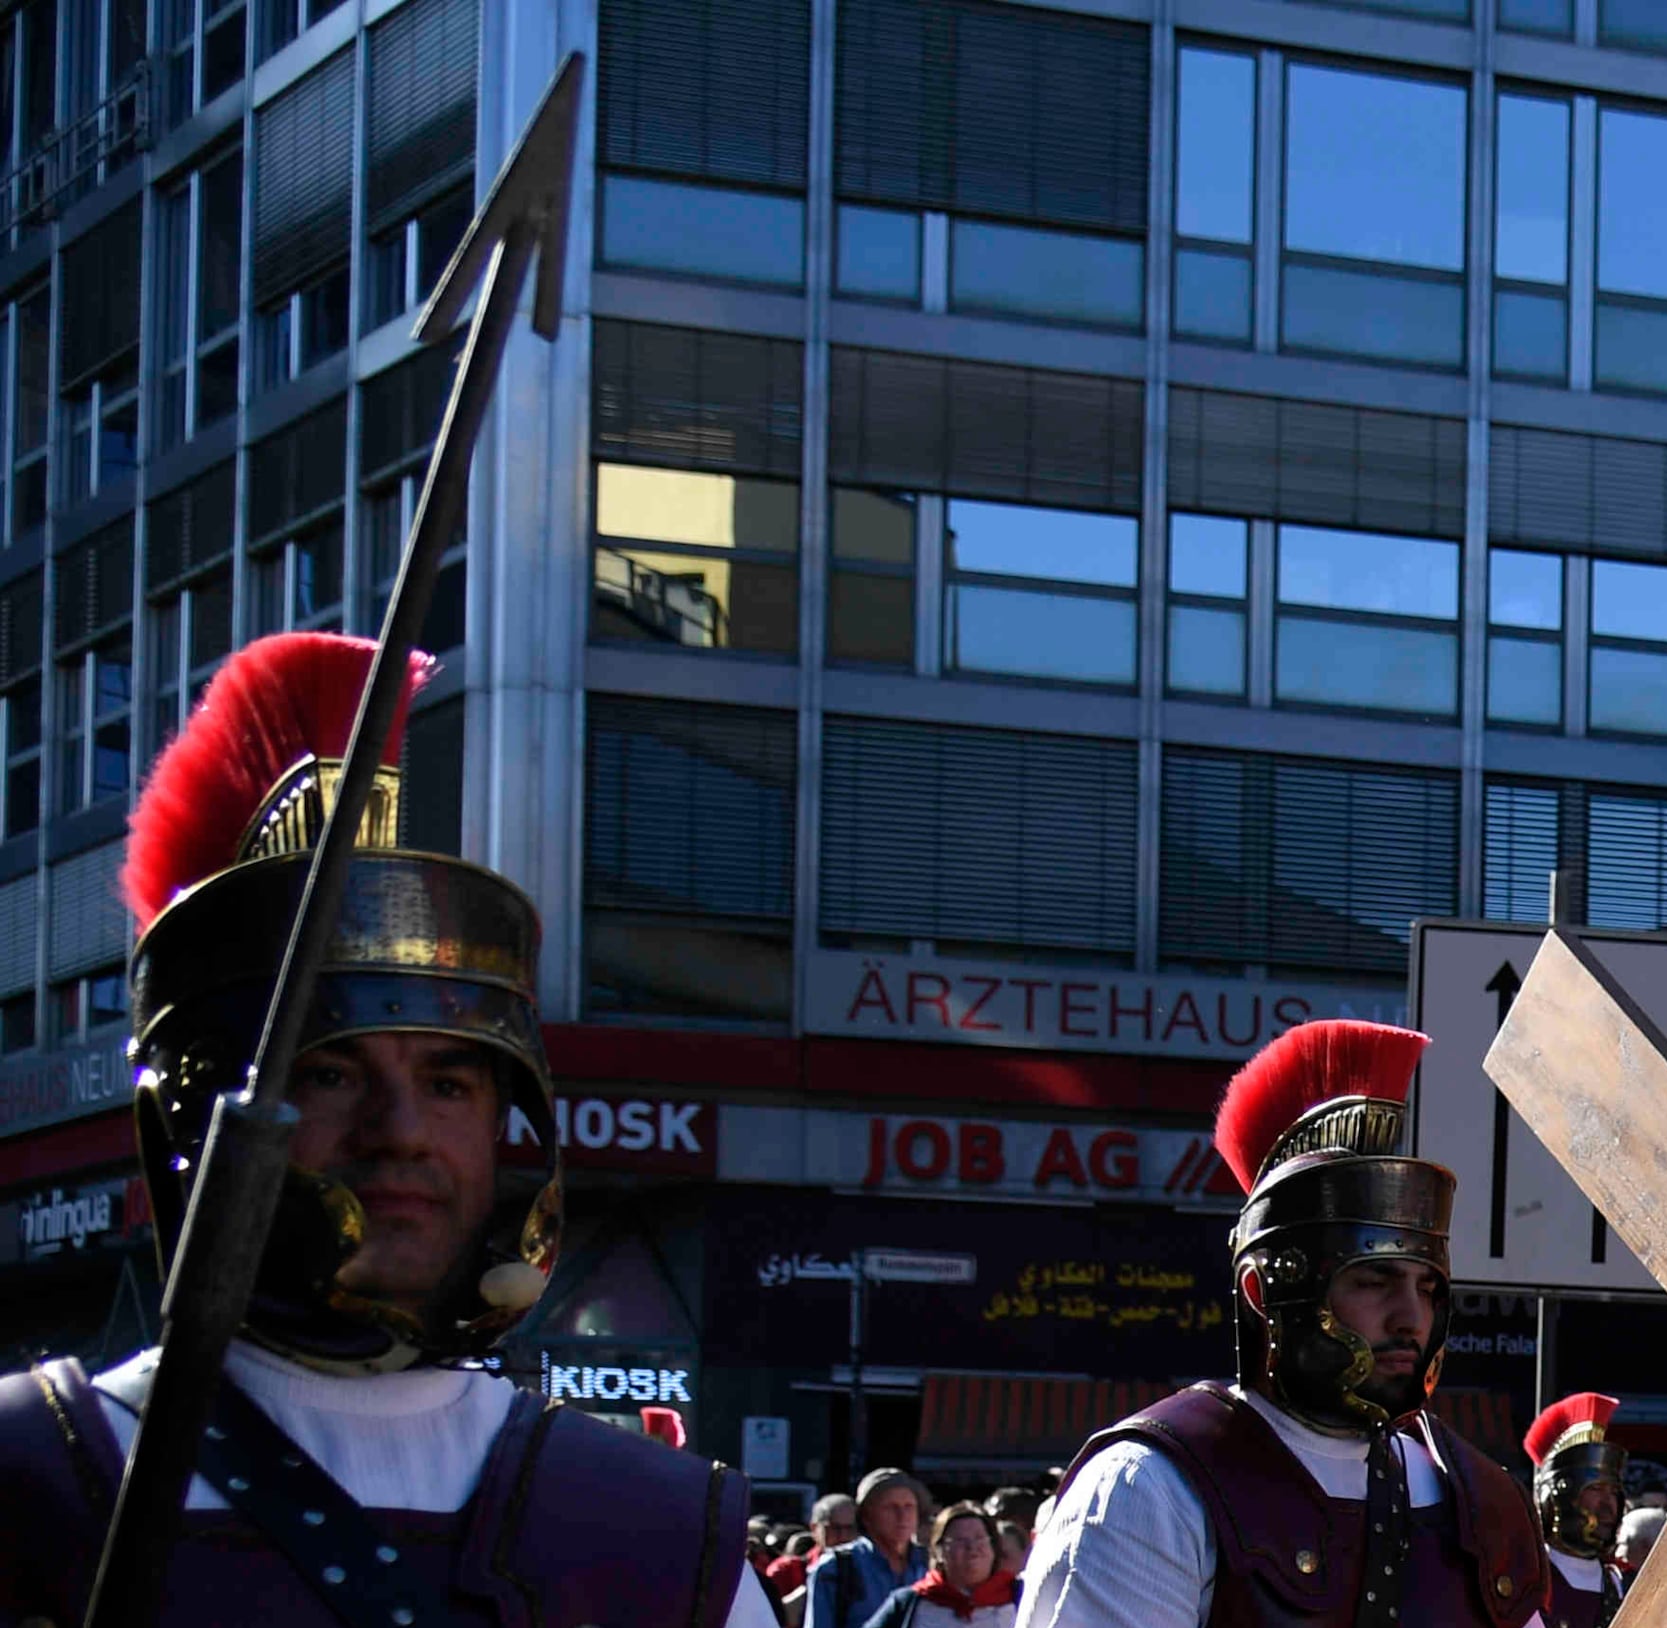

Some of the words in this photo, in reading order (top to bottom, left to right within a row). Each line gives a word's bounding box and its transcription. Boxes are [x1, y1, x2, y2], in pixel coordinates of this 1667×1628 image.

[846, 960, 1312, 1047] ÄRZTEHAUS
[862, 1119, 1004, 1187] JOB
[1035, 1128, 1140, 1188] AG
[34, 1188, 110, 1250] inlingua
[1447, 1332, 1492, 1354] sche
[1496, 1333, 1537, 1356] Fala
[550, 1364, 693, 1403] KIOSK
